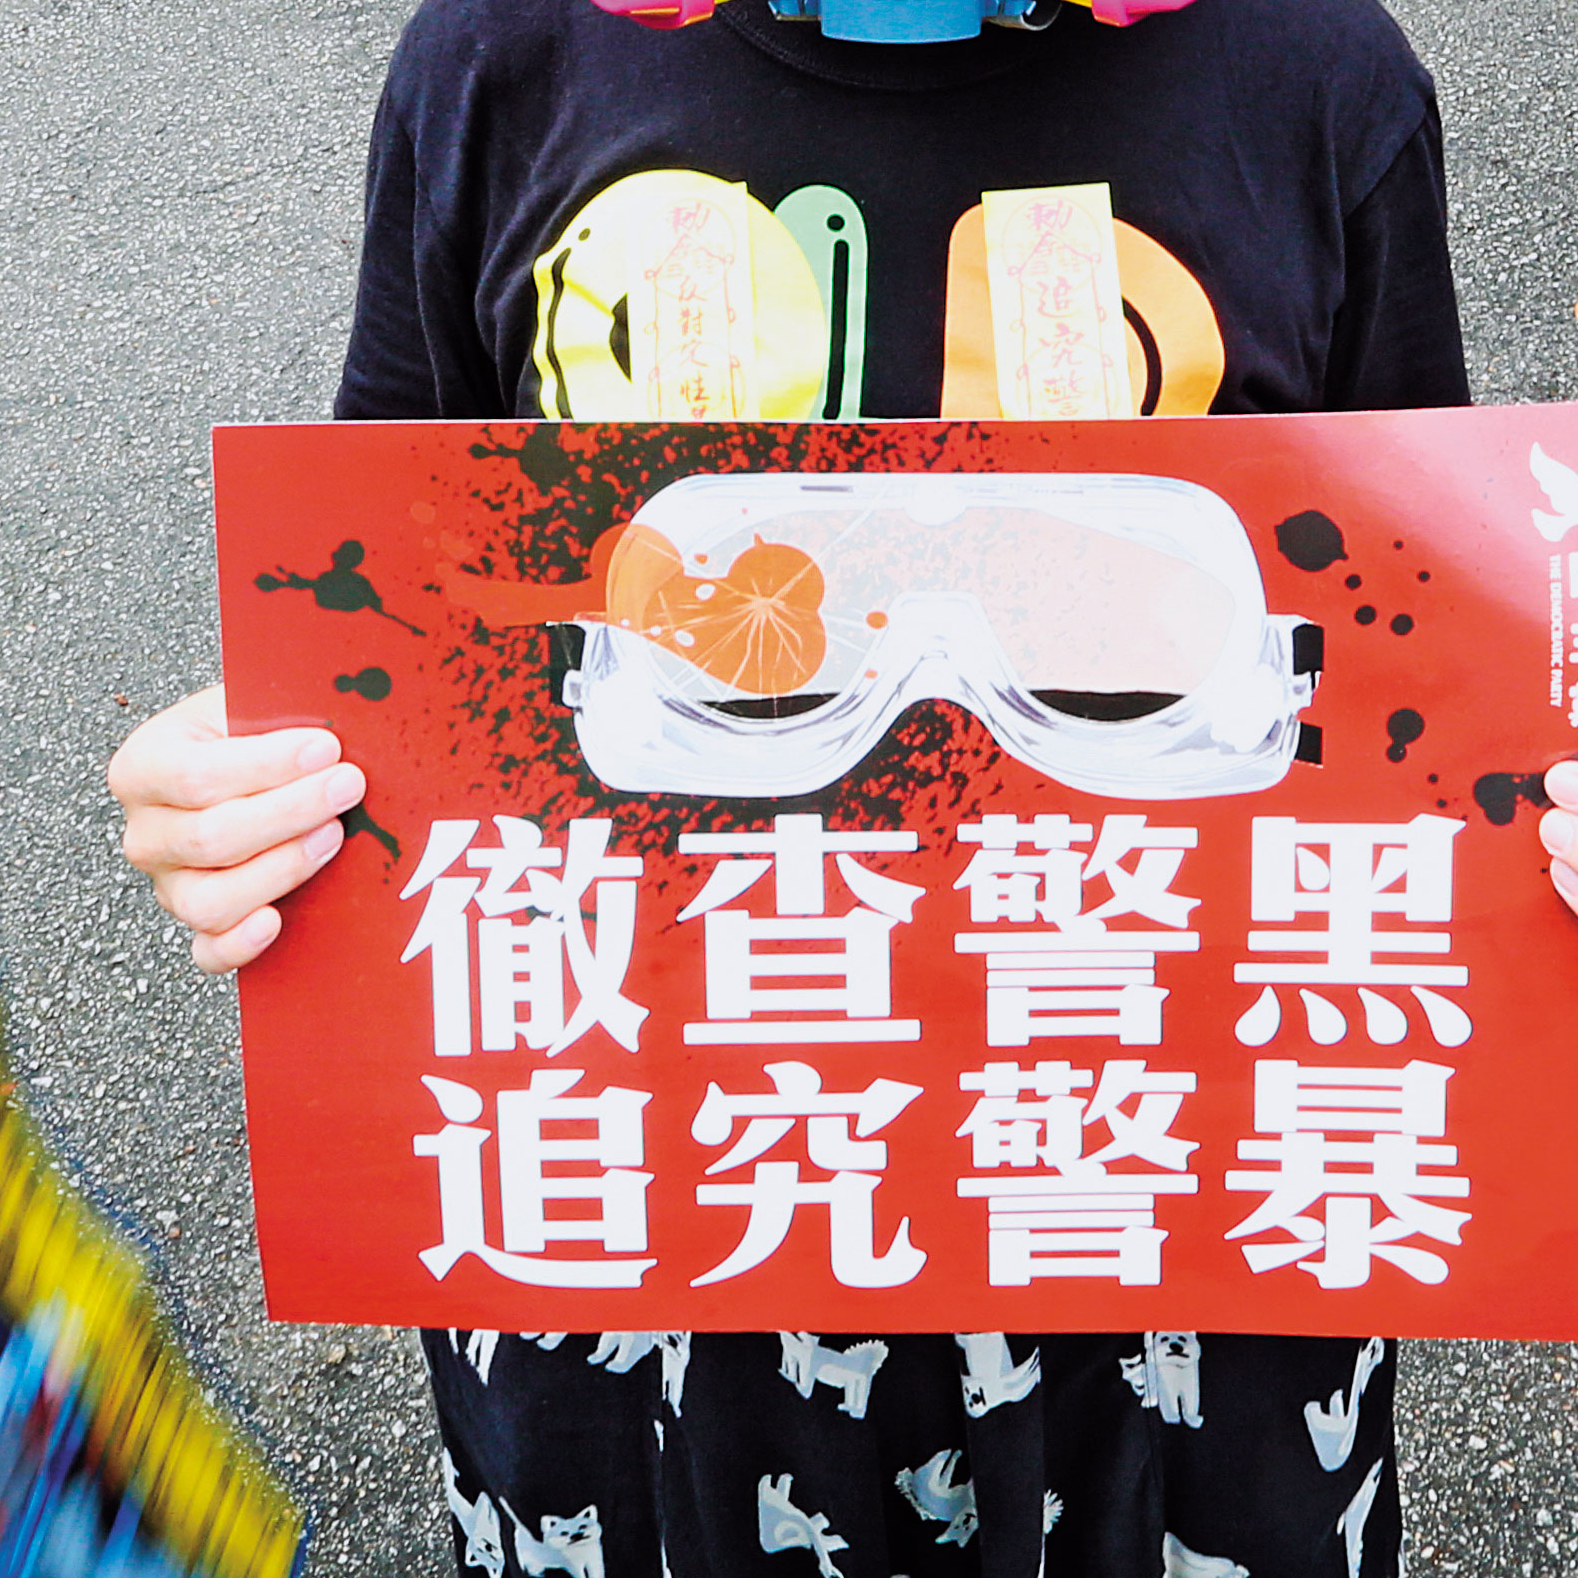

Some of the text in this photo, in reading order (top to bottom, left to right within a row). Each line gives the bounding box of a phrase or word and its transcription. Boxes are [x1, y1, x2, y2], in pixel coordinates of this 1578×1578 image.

[1549, 553, 1564, 708] THE DEMOCRATIC PARTY
[399, 813, 1473, 1057] 徹查警黑
[412, 1059, 1473, 1289] 追究警暴
